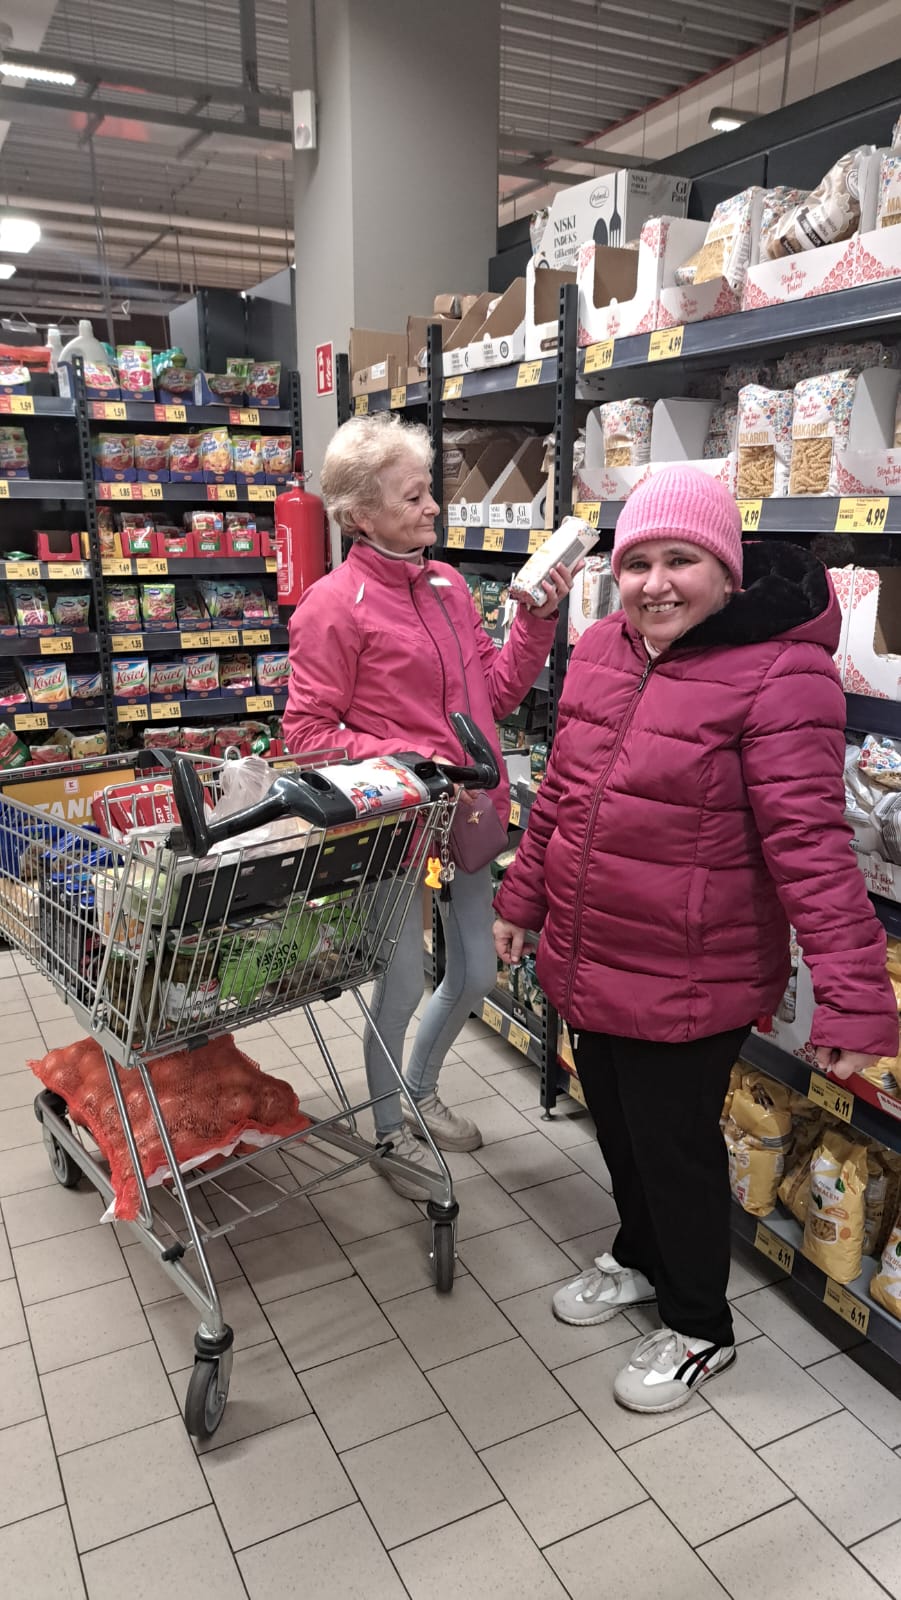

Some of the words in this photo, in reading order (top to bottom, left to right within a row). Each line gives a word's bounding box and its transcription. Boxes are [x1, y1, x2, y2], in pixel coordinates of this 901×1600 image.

[553, 215, 577, 233] NISKI
[553, 231, 577, 248] INDEKS
[744, 510, 760, 526] 4.99
[866, 508, 886, 526] 4.99
[116, 667, 145, 684] Kisiel
[187, 660, 214, 678] Kisiel
[263, 659, 289, 675] Kisiel
[33, 671, 62, 690] Kisiel
[153, 669, 181, 684] Kisiel
